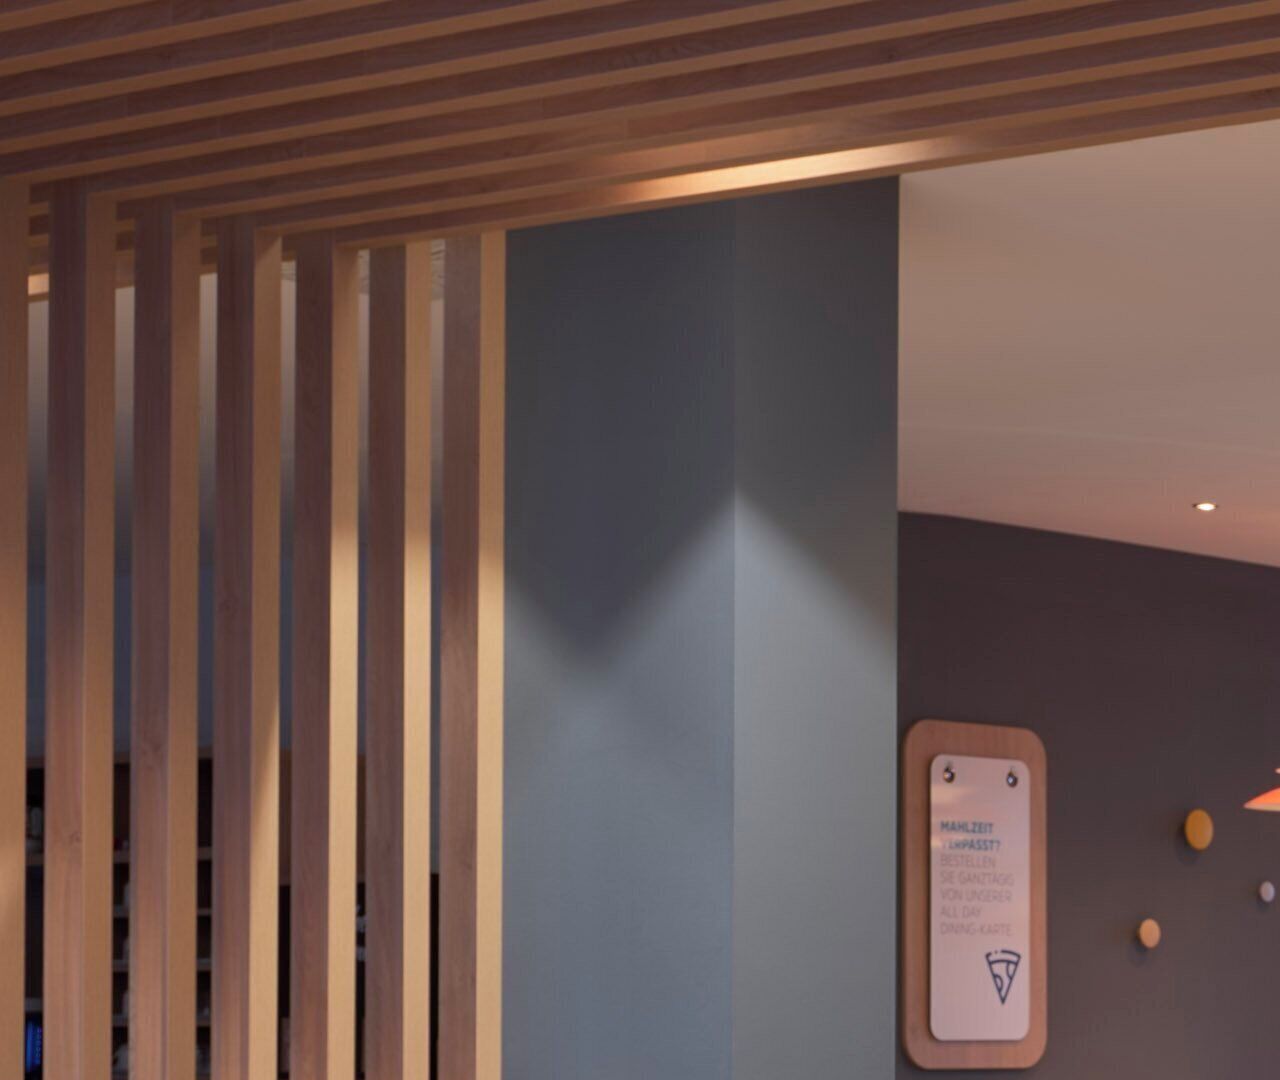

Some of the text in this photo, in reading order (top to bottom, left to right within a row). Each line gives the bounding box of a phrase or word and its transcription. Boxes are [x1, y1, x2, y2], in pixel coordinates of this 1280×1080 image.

[940, 820, 993, 834] MAHLZEIT
[940, 838, 1001, 852] ERPASST?
[940, 854, 996, 869] BESTELLEN
[940, 904, 982, 918] ALL DAY
